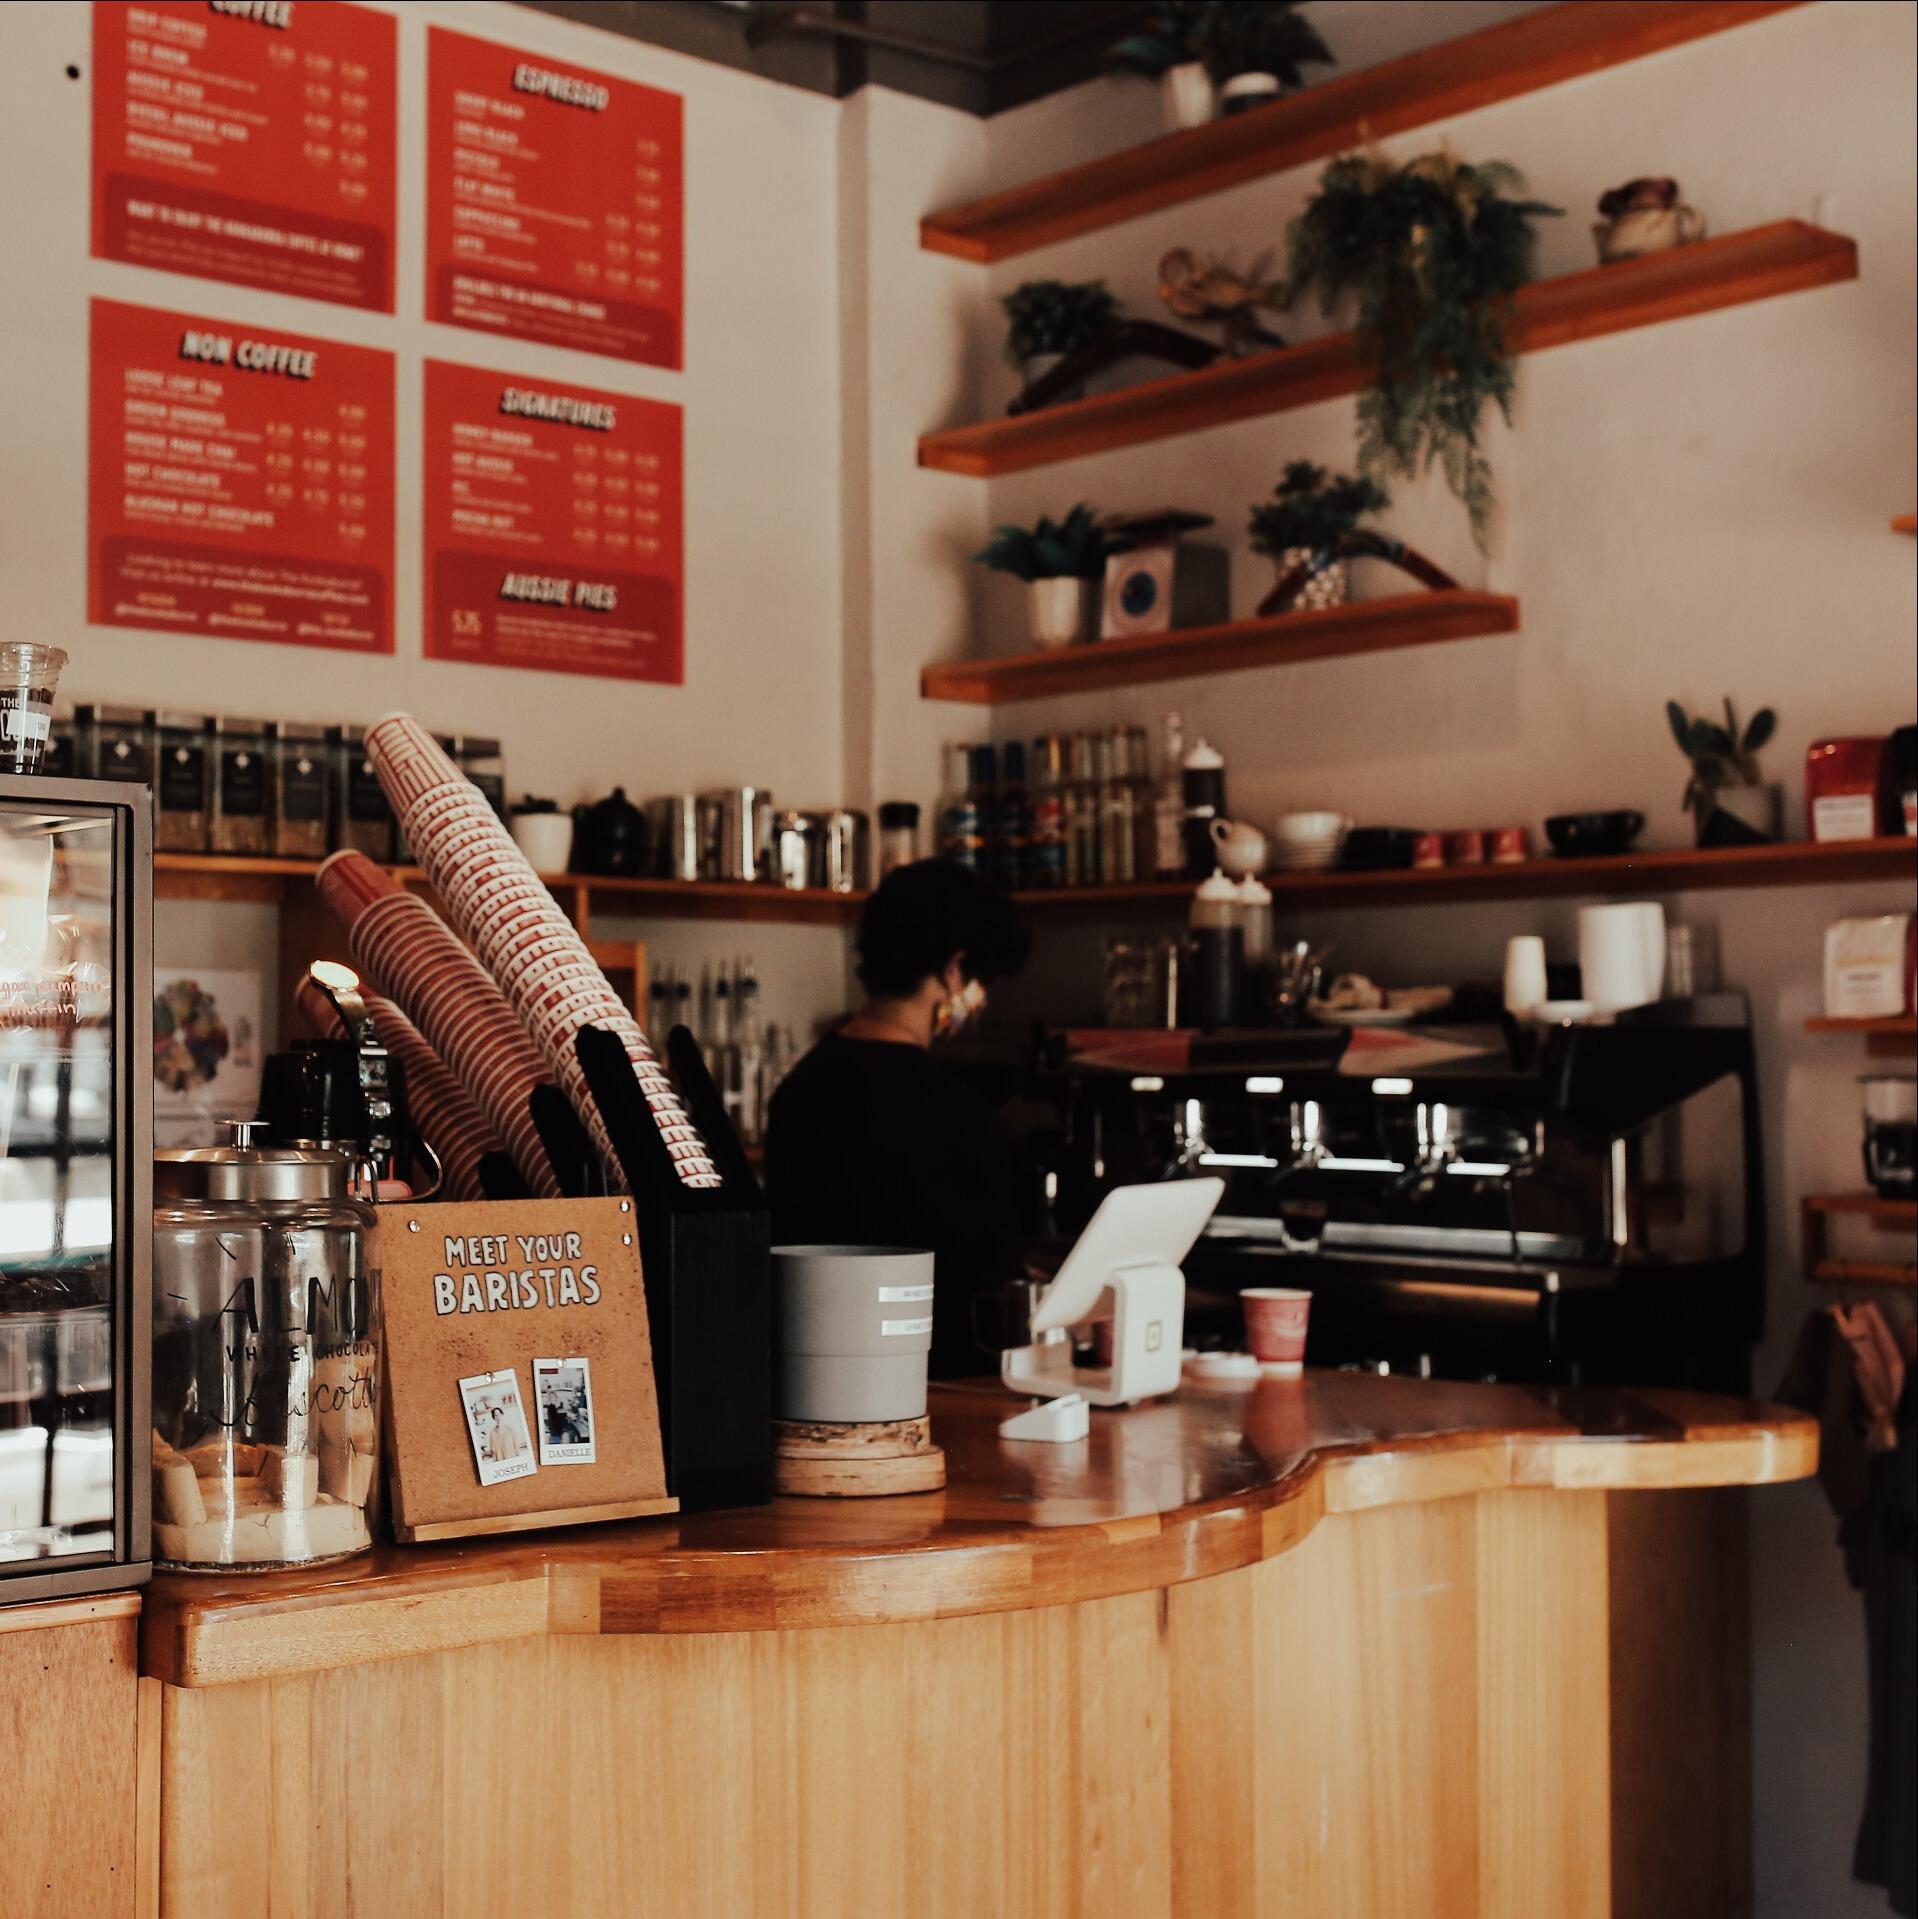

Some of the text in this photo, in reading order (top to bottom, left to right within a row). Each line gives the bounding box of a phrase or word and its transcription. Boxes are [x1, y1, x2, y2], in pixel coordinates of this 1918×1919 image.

[513, 63, 609, 111] ESPRESSO
[180, 329, 317, 380] NON COFFEE
[499, 386, 616, 431] SIGNATURES
[498, 572, 617, 612] AUSSIE PIES
[444, 1231, 582, 1267] MEET YOUR
[433, 1264, 602, 1315] BARISTAS
[493, 1462, 530, 1479] JOSEPH
[548, 1447, 592, 1459] DANIELLE
